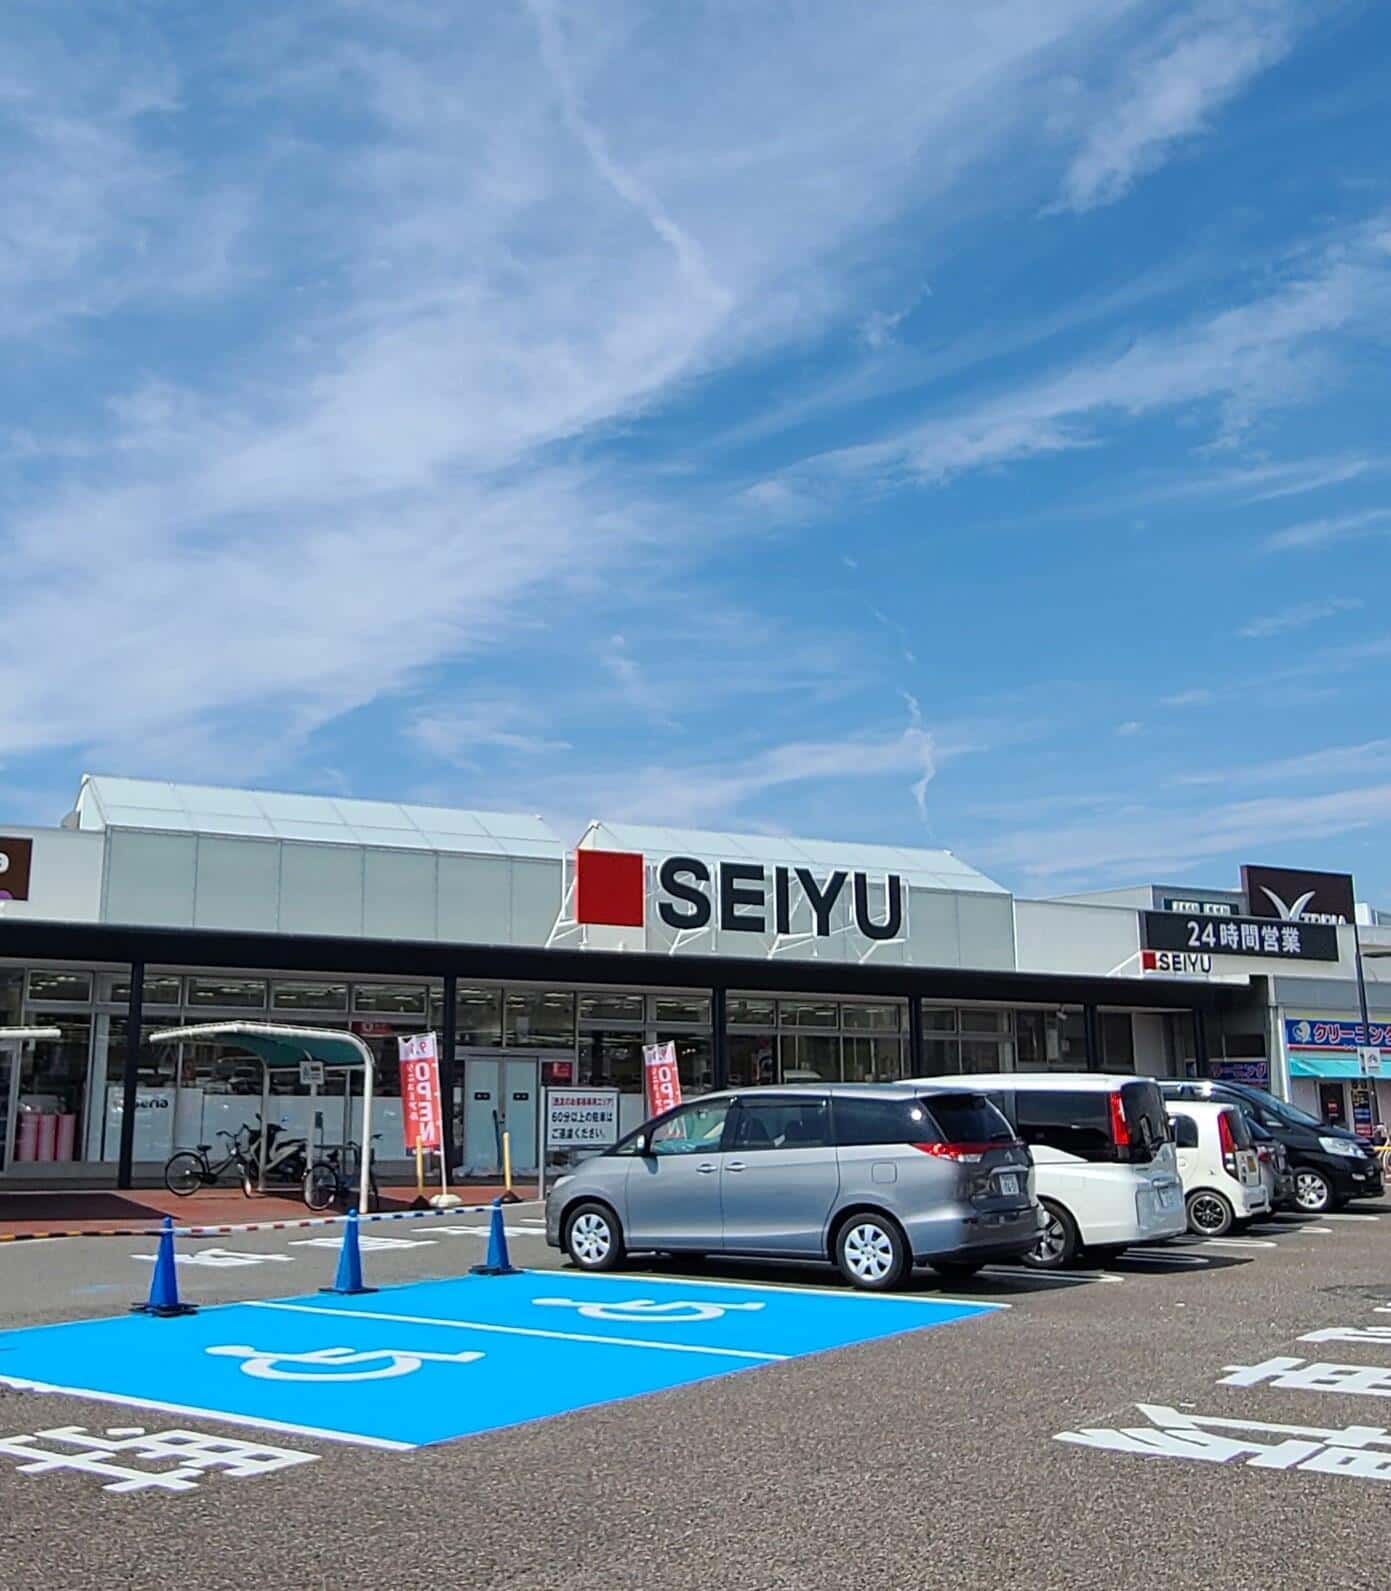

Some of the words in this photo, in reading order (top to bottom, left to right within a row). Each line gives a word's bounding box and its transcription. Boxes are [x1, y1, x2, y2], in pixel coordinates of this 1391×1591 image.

[657, 855, 904, 941] SEIYU
[1186, 920, 1301, 954] 24時間営業
[1159, 953, 1212, 974] SEIYU
